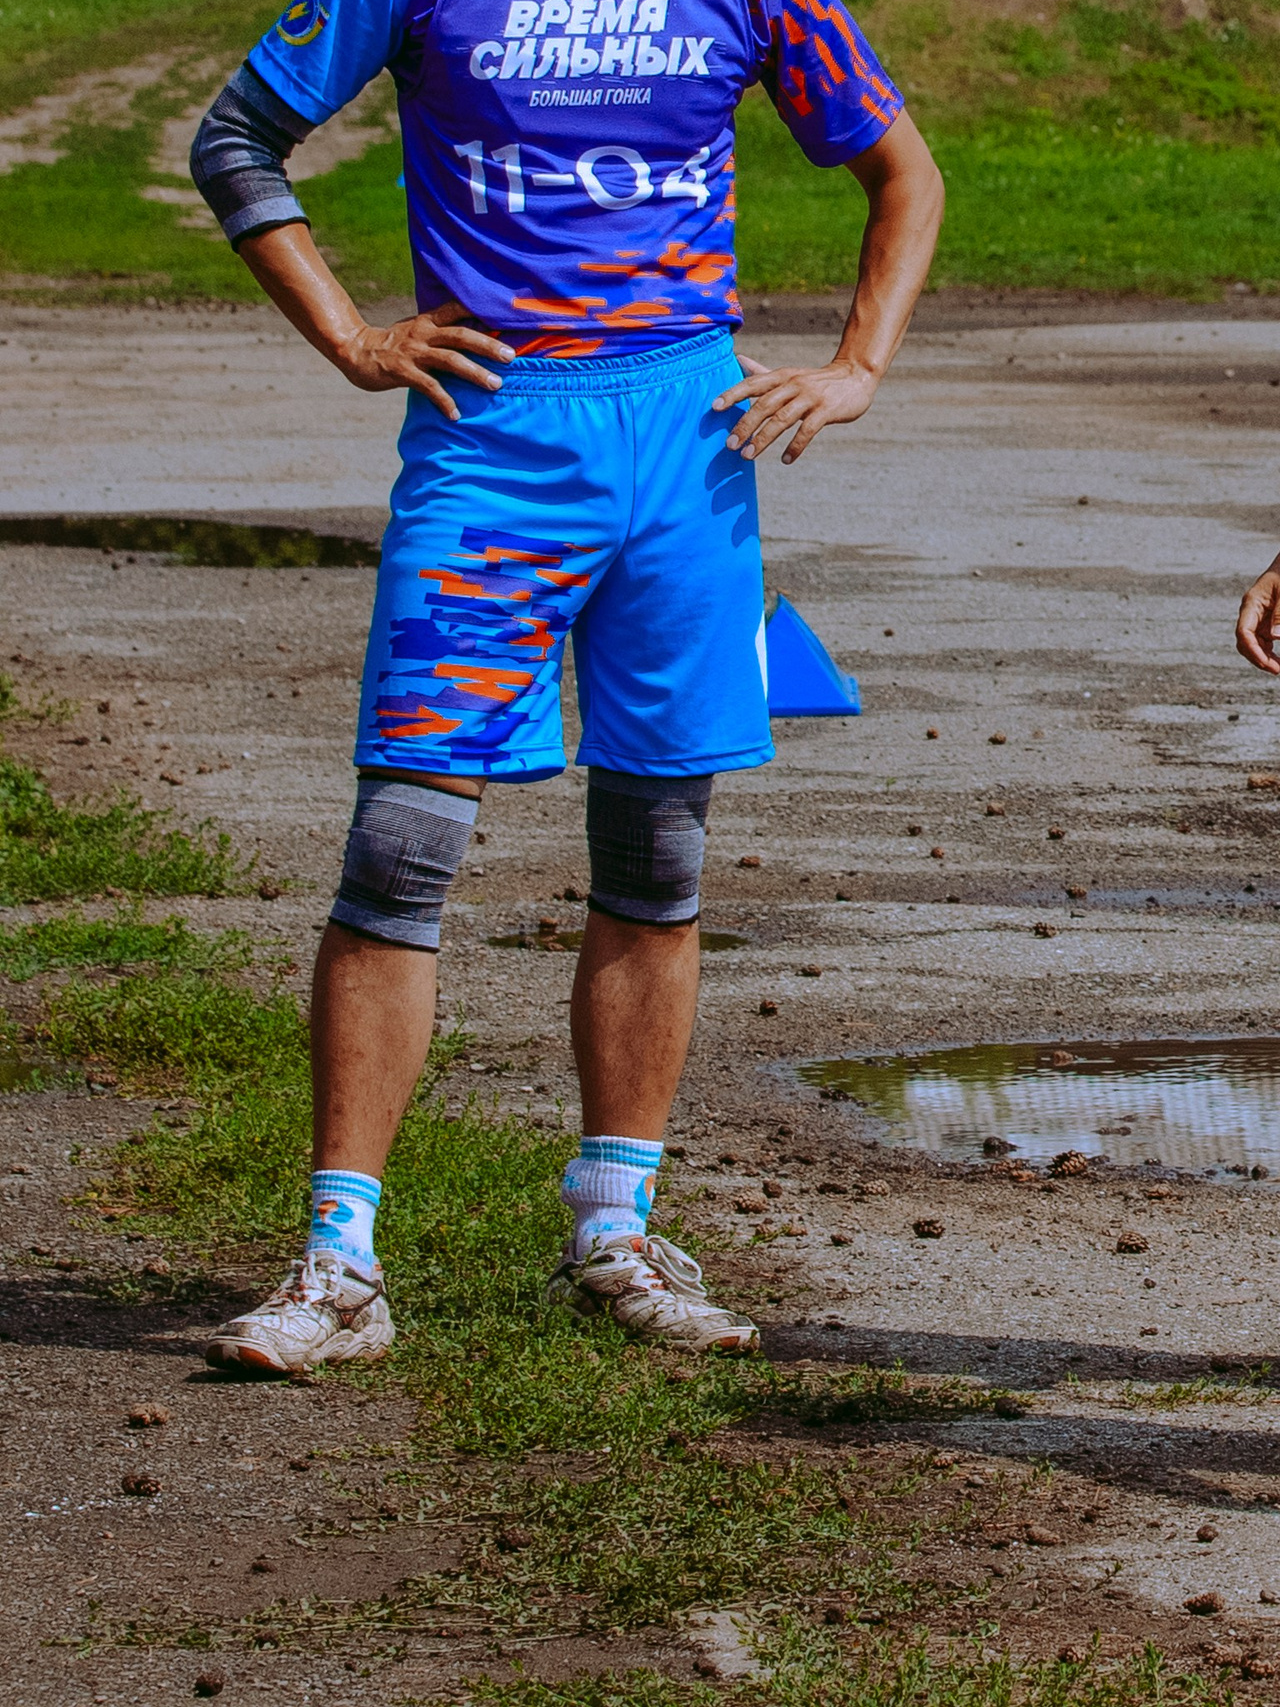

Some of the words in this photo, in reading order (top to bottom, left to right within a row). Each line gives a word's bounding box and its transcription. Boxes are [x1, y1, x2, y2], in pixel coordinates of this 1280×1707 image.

[469, 35, 715, 79] СИЛЬНЫХ
[529, 89, 601, 106] БОЛЬШАЯ
[604, 88, 651, 105] ГОНКА
[454, 140, 711, 214] 11-04
